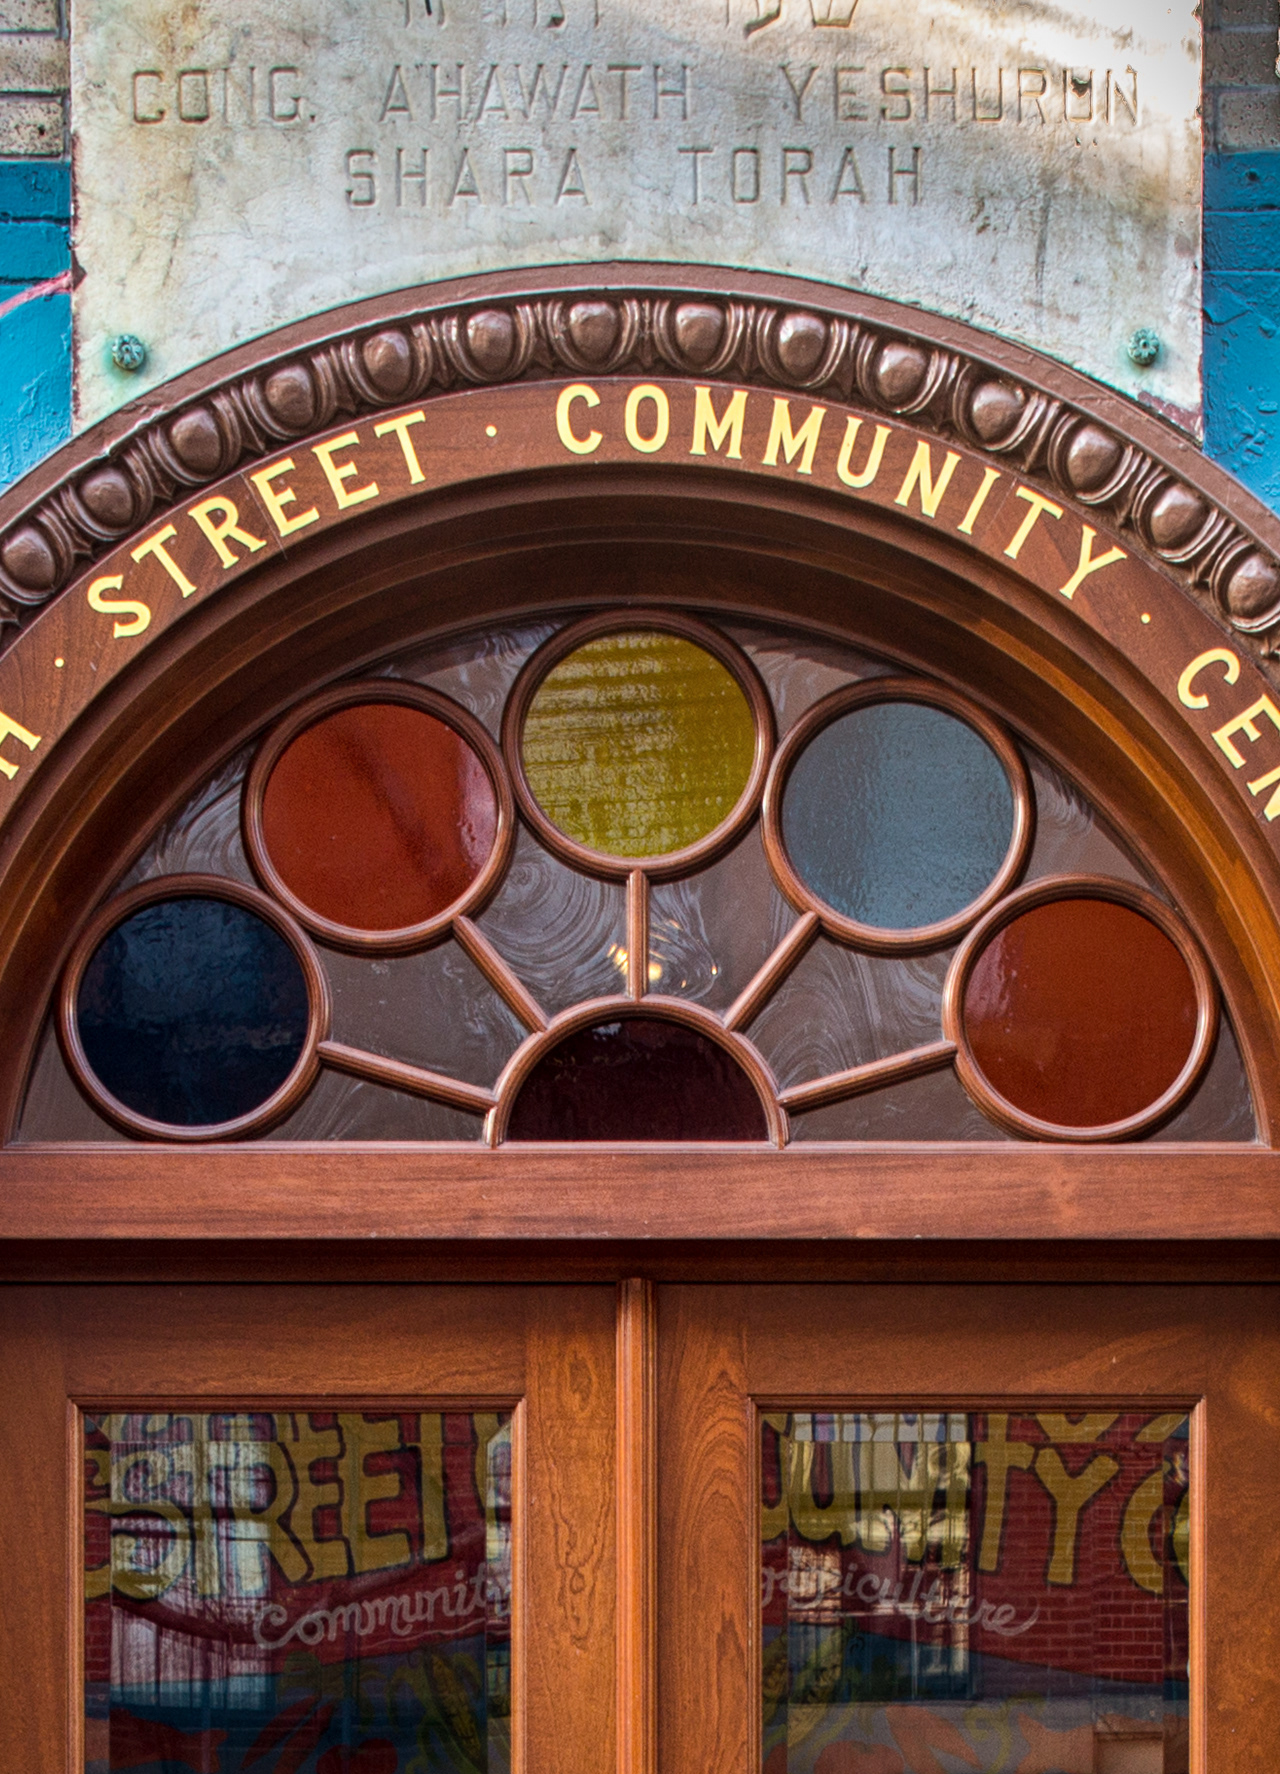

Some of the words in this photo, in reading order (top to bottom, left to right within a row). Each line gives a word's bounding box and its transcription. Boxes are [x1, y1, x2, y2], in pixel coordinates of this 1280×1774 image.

[379, 62, 692, 122] AHAWATH
[778, 62, 1142, 129] YESHURUN
[344, 145, 588, 210] SHARA
[679, 143, 924, 209] TORAH
[86, 410, 427, 640] STREET
[554, 383, 1127, 601] COMMUNITY
